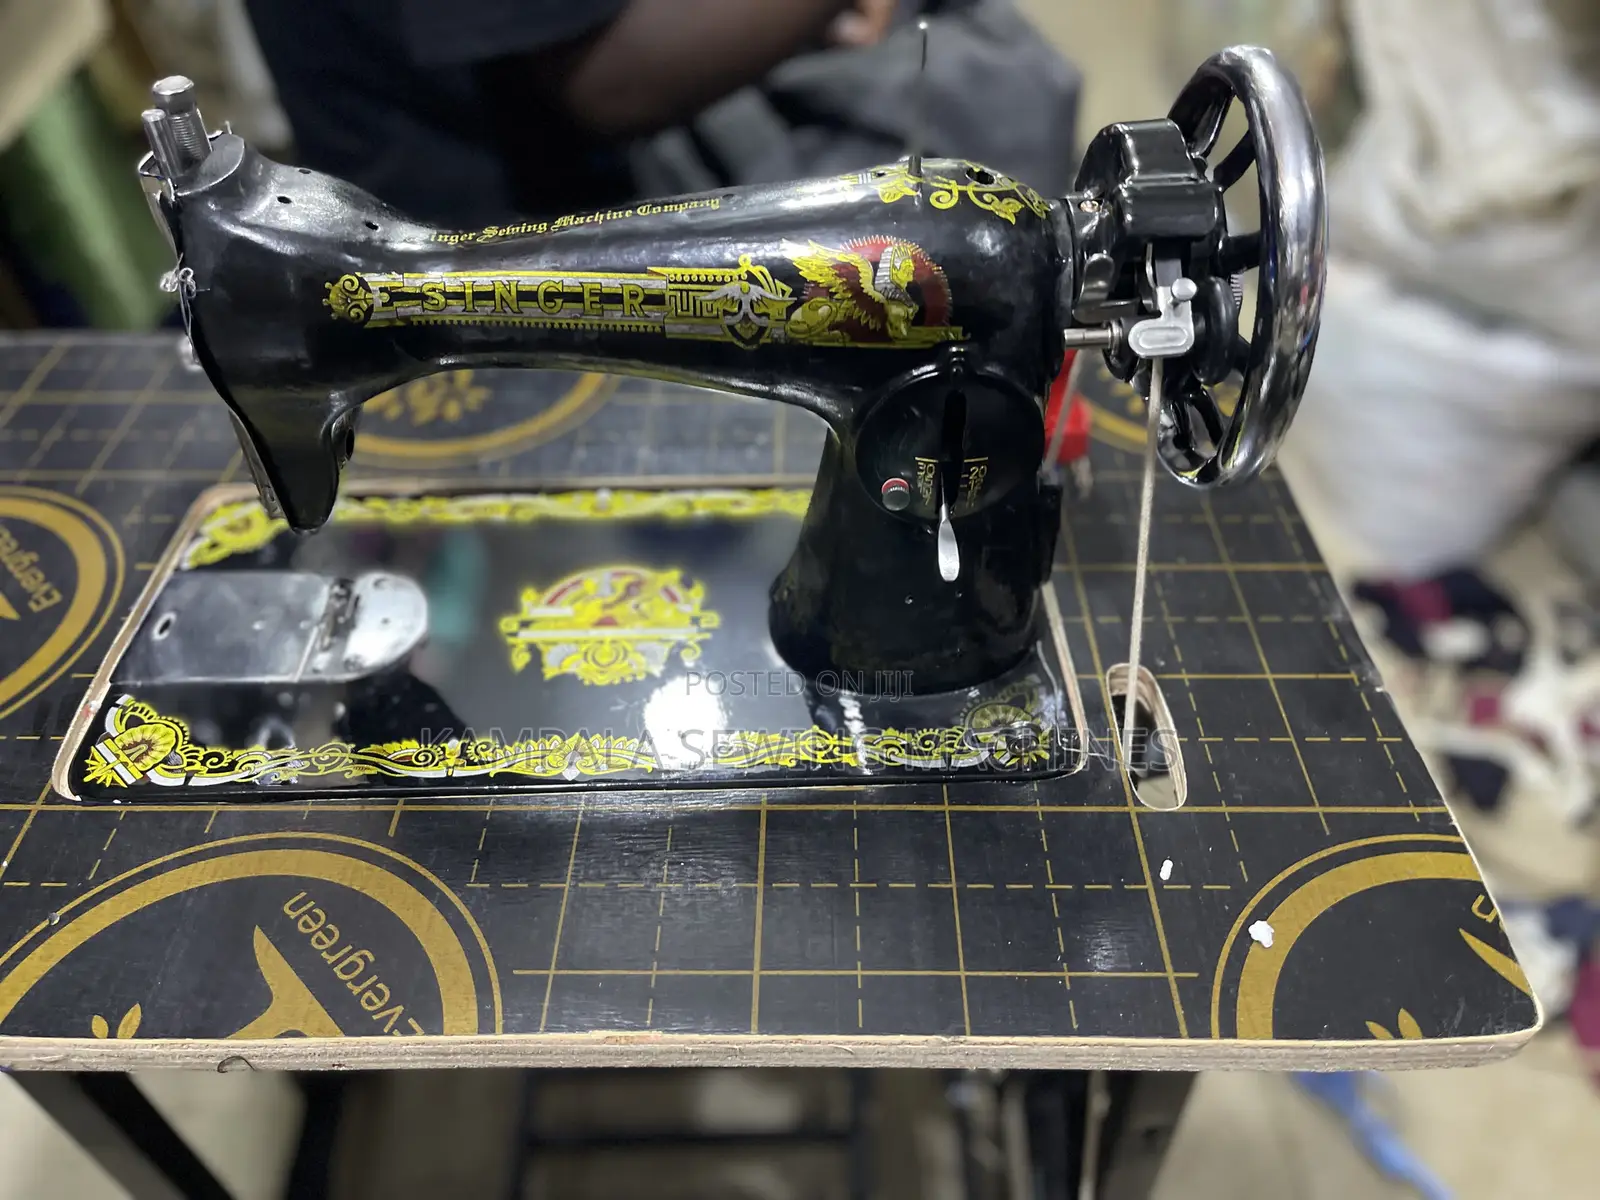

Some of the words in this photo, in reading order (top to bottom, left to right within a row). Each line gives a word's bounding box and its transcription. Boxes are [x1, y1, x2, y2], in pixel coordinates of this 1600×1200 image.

[428, 229, 476, 245] inger
[476, 222, 548, 244] Sewing
[551, 209, 632, 232] Machine
[420, 279, 649, 318] SINGER
